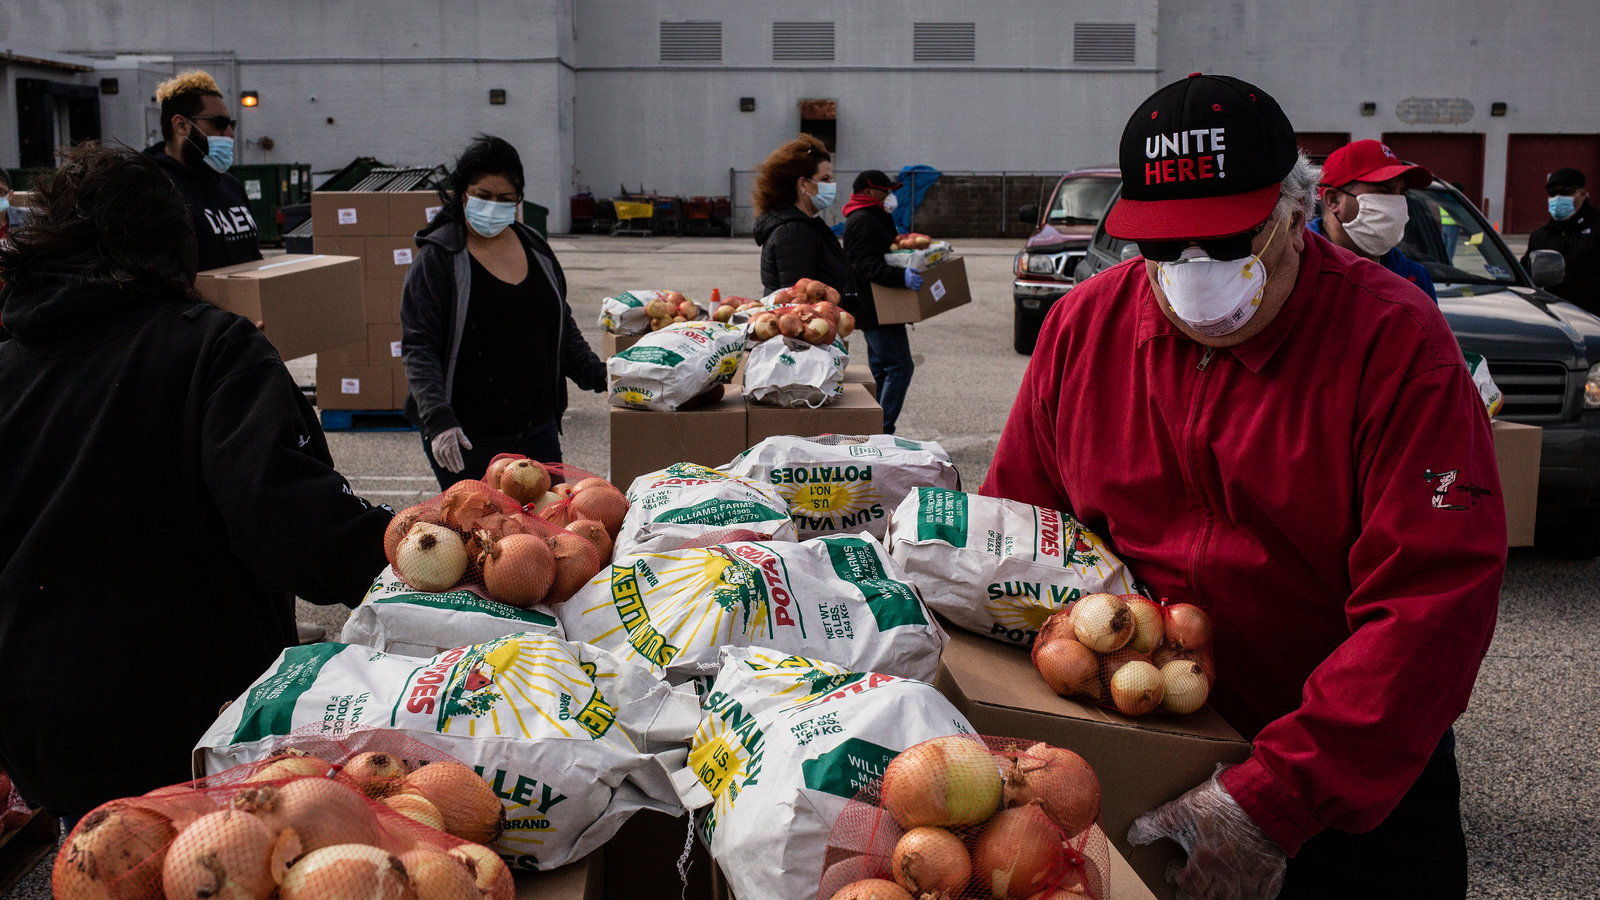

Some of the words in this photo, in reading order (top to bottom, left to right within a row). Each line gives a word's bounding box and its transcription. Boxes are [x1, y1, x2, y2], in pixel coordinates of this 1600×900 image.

[1145, 127, 1226, 159] UNITE
[1145, 153, 1225, 185] HERE!
[705, 351, 720, 373] SUN
[613, 386, 628, 395] SUN
[629, 386, 654, 399] VALLEY
[770, 465, 872, 484] POTATOES
[809, 485, 831, 496] NO.1
[669, 506, 718, 524] WILLIAMS
[719, 501, 756, 512] FARMS
[811, 498, 830, 509] U.S.
[713, 512, 726, 521] NY
[727, 508, 751, 517] 14505
[792, 515, 836, 531] VAL
[841, 503, 885, 530] SUN
[1038, 506, 1060, 558] TATOES
[843, 545, 864, 579] FARMS
[857, 550, 870, 573] 14505
[636, 558, 660, 589] BRAND
[987, 580, 1042, 601] SUN
[818, 602, 829, 621] WT.
[829, 604, 841, 627] LBS.
[839, 602, 851, 620] KG.
[820, 620, 835, 640] NET
[834, 627, 846, 640] 10
[844, 620, 855, 640] 4.54
[627, 624, 682, 669] SUN
[790, 718, 815, 734] NET
[702, 691, 744, 731] SUN
[735, 712, 766, 788] VALLEY
[797, 728, 821, 747] 4.54
[712, 743, 729, 772] U.S.
[848, 753, 888, 778] WILLI
[698, 761, 723, 792] NO.1
[504, 819, 551, 830] BRAND
